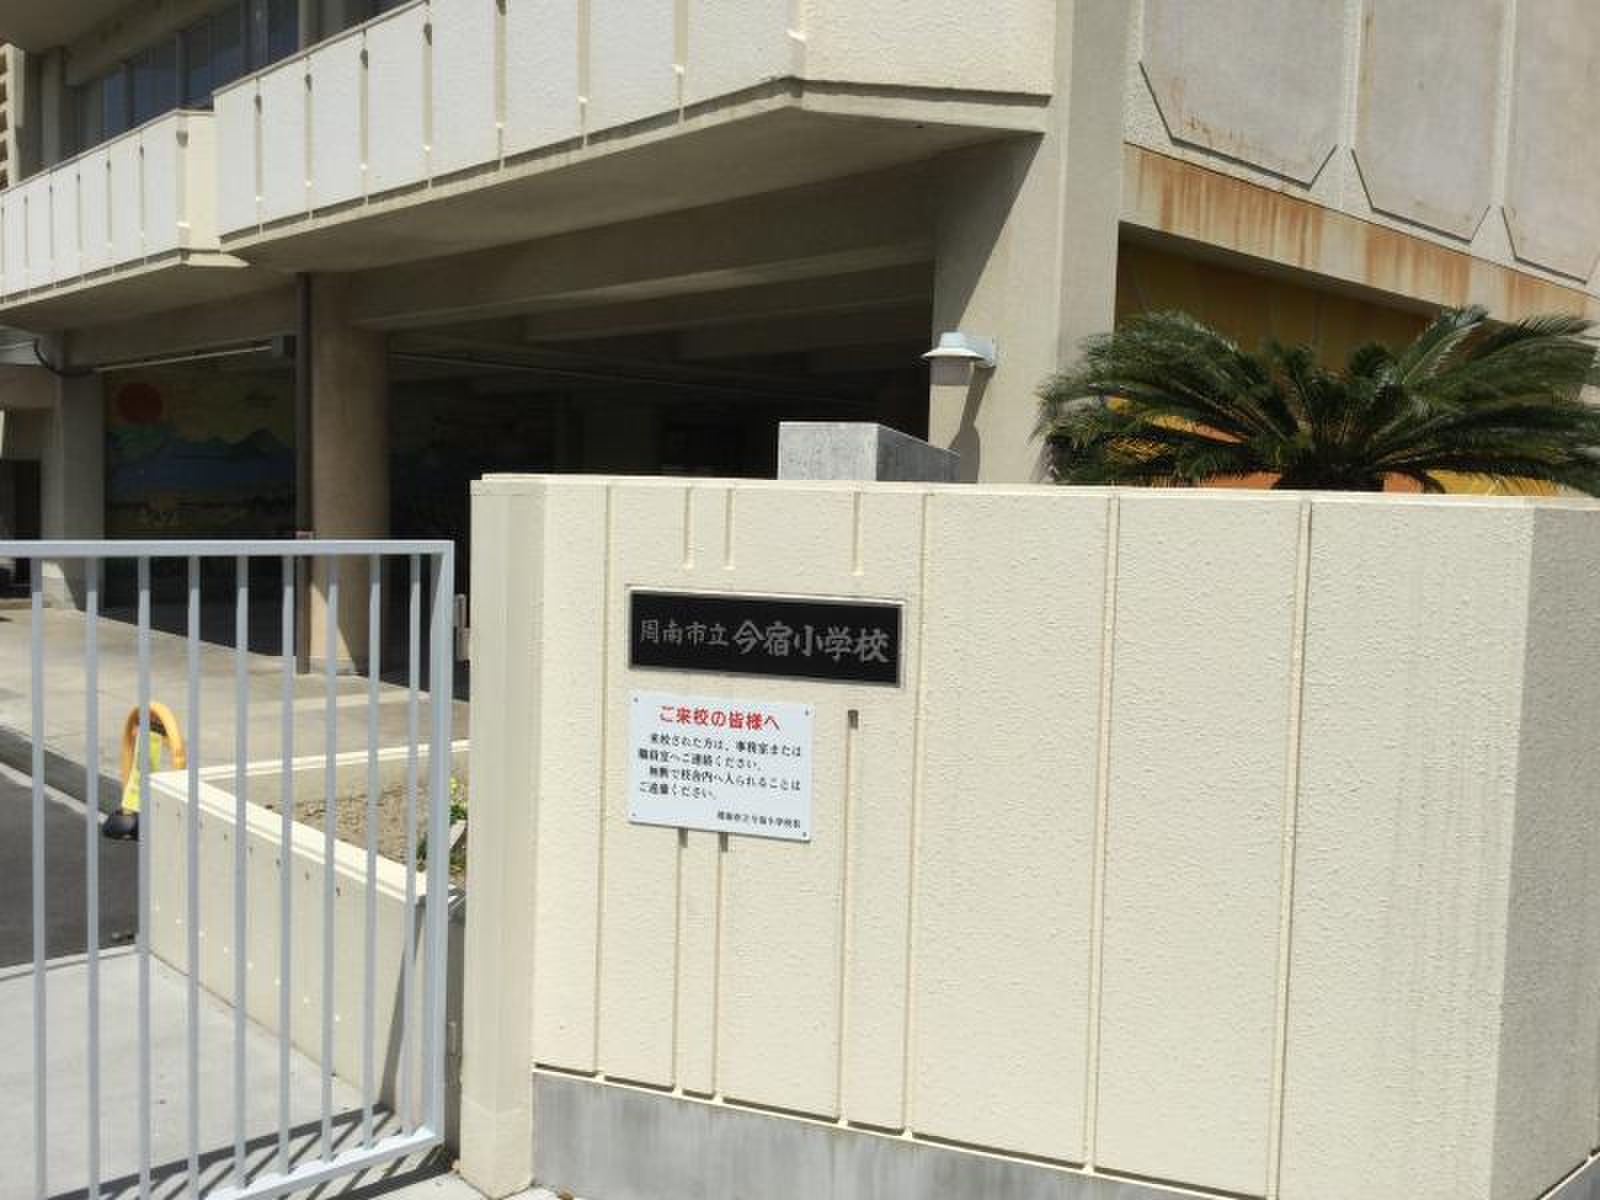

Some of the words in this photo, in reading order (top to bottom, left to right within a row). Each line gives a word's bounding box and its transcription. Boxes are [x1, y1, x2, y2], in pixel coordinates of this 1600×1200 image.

[640, 618, 889, 663] 周南市立今宿小学校
[660, 705, 781, 731] ご来校の皆様へ
